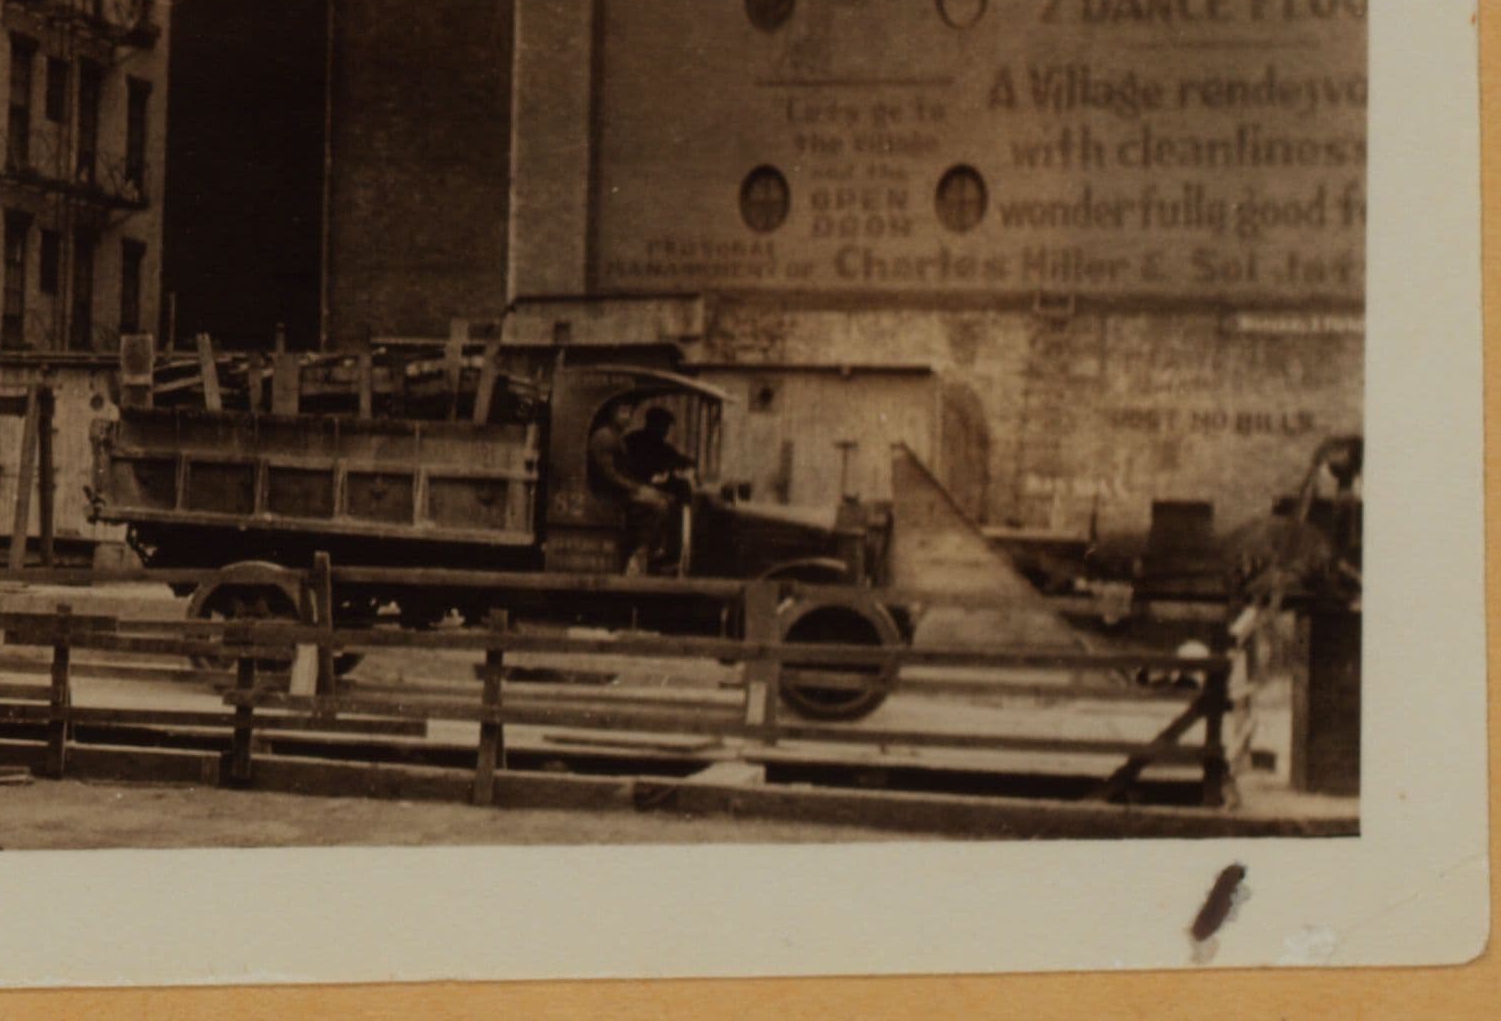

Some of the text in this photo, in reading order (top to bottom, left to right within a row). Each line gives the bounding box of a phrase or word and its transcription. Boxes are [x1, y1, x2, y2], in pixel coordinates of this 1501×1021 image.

[987, 65, 1017, 110] A
[1027, 62, 1163, 120] Village
[1010, 125, 1105, 169] with
[834, 243, 1012, 281] Charles
